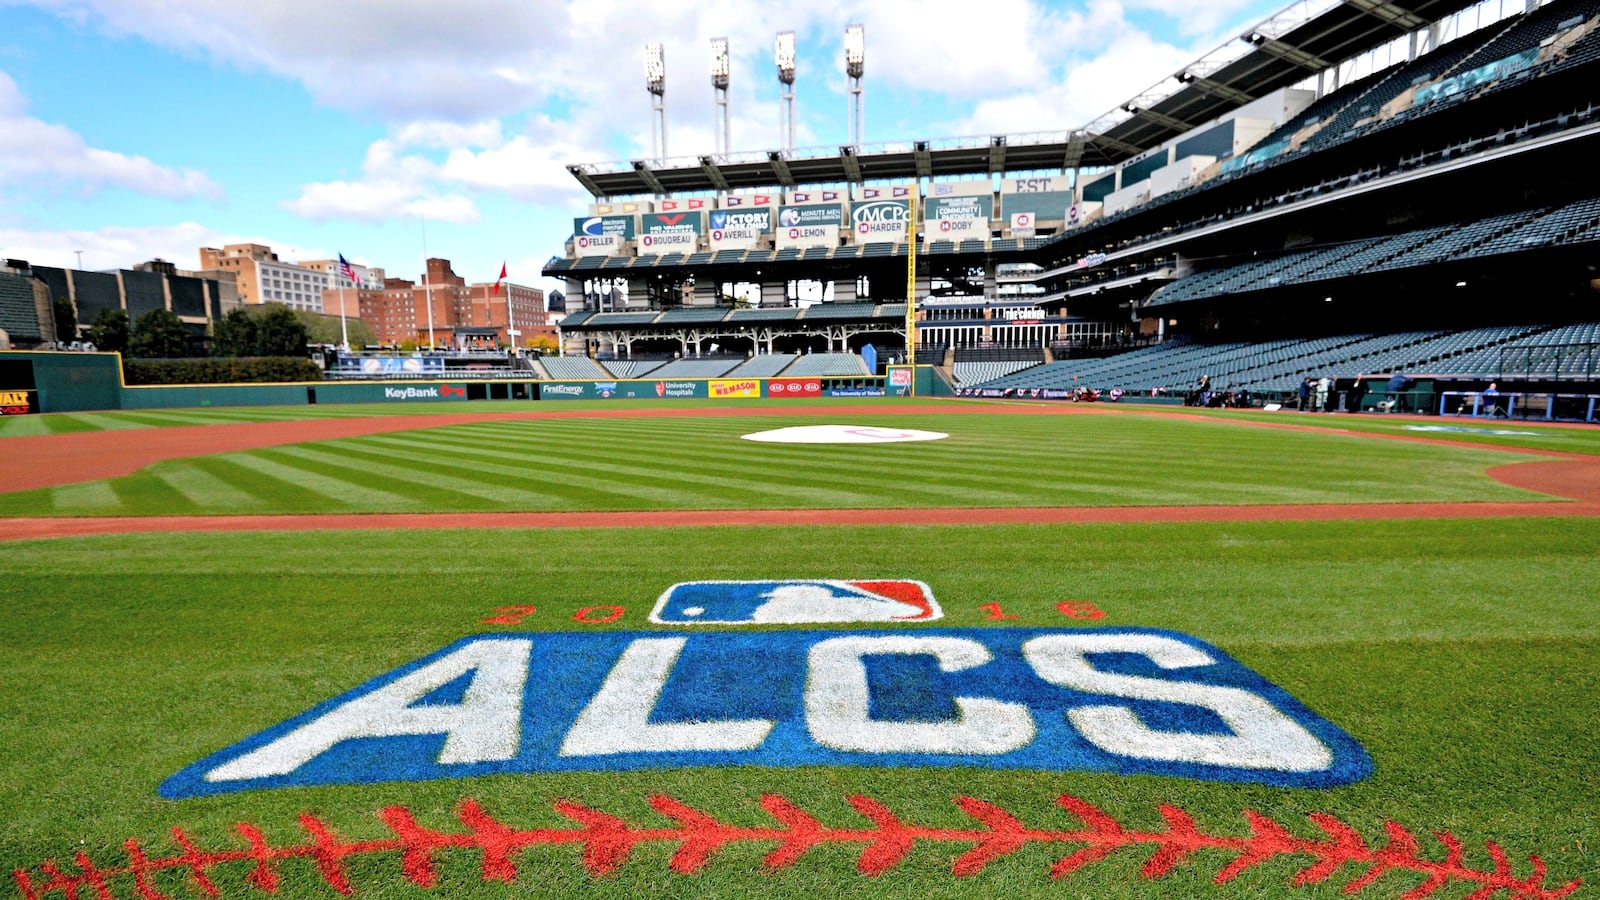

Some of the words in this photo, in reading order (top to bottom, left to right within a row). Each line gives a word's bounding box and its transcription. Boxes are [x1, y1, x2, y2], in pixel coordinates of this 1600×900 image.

[801, 209, 825, 217] MINUTE
[826, 208, 840, 216] MEN
[939, 207, 979, 215] COMMUNITY
[870, 222, 902, 232] HARDER
[951, 221, 973, 230] DOBY
[723, 231, 753, 239] AVERILL
[800, 228, 826, 237] LEMON
[589, 237, 614, 246] FELLER
[653, 235, 691, 245] BOUDREAU
[1005, 309, 1018, 320] THE
[1019, 308, 1046, 320] CORNER
[666, 382, 696, 390] University
[384, 387, 438, 399] KeyBank
[666, 389, 694, 397] Hospitals
[203, 633, 1335, 784] ALCS
